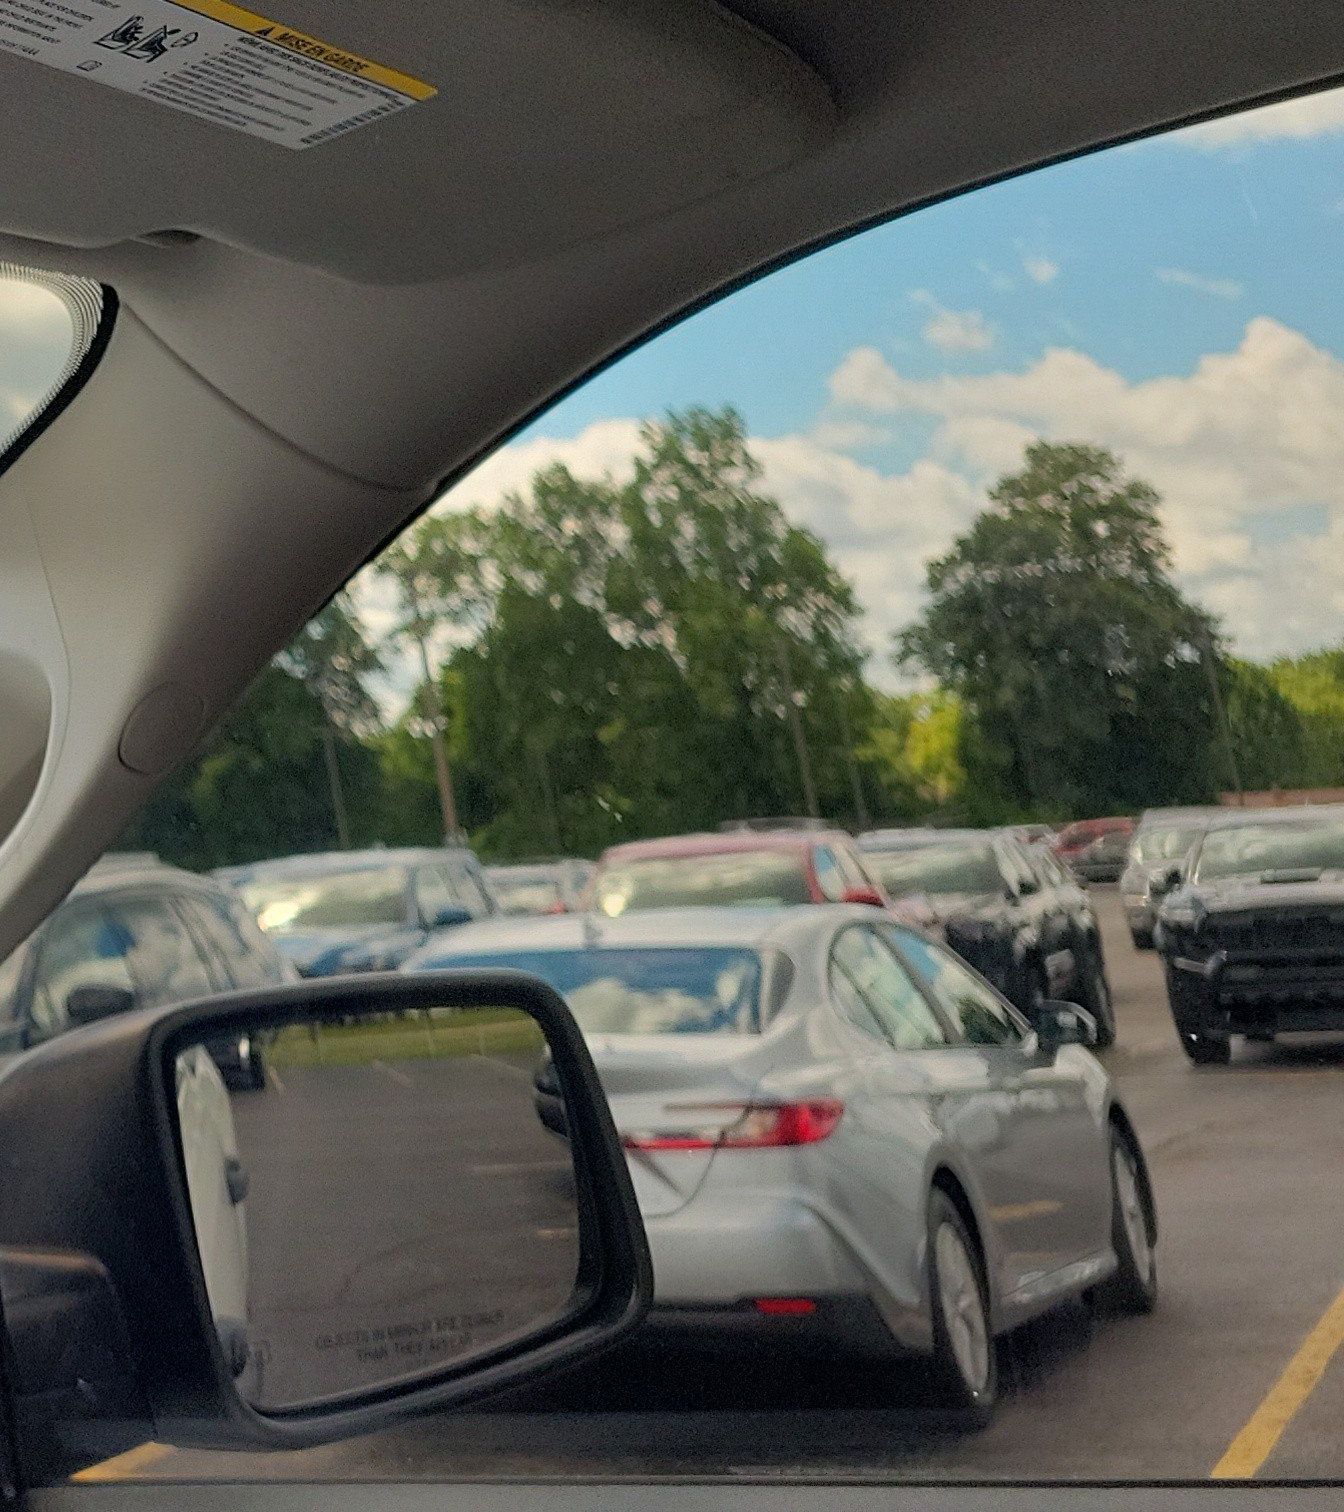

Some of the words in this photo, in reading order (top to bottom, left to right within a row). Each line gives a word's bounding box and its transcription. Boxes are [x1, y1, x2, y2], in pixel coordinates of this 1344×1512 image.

[274, 33, 312, 49] MISE
[305, 45, 327, 56] EN
[323, 52, 369, 71] GARDE
